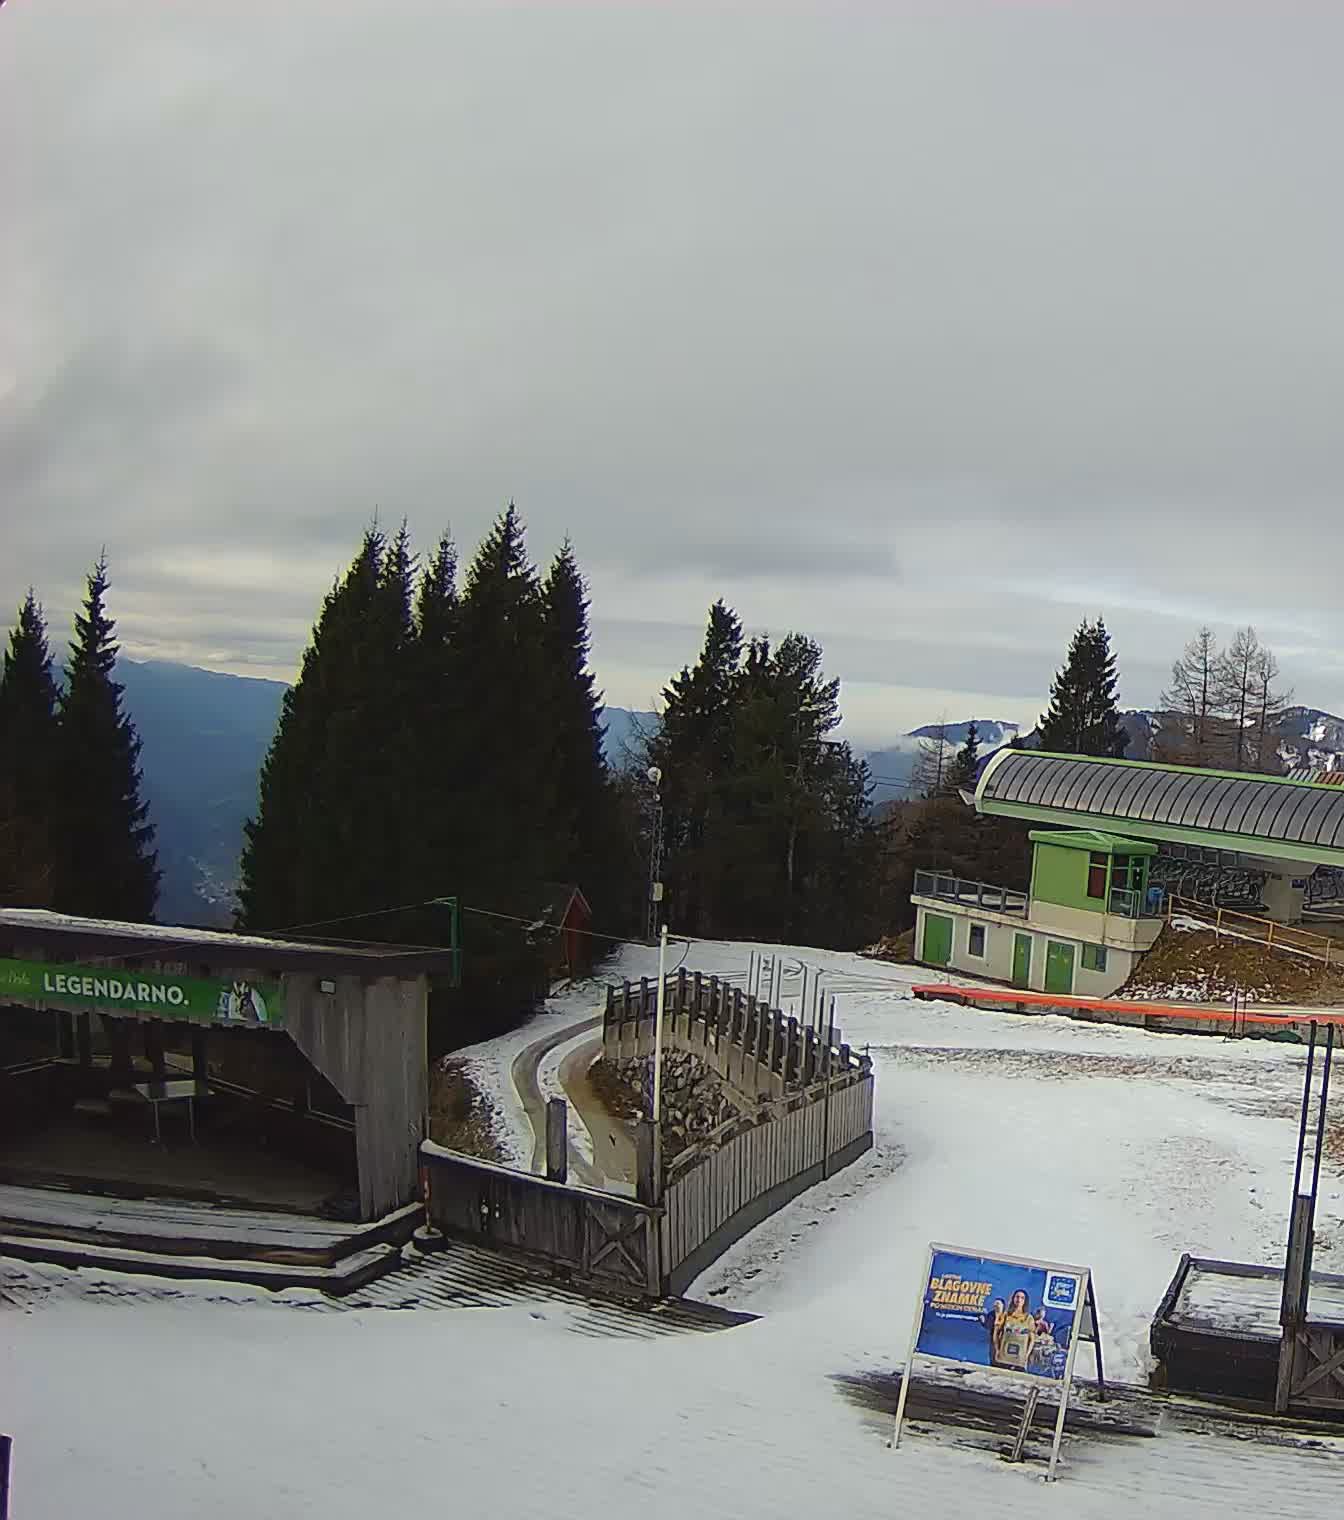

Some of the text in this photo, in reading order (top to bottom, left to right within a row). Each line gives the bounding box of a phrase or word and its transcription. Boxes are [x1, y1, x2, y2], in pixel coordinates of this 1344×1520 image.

[43, 972, 190, 1007] LEGENDARNO.
[930, 1277, 993, 1296] BLAGOVNE
[932, 1290, 986, 1308] ZNAMKE
